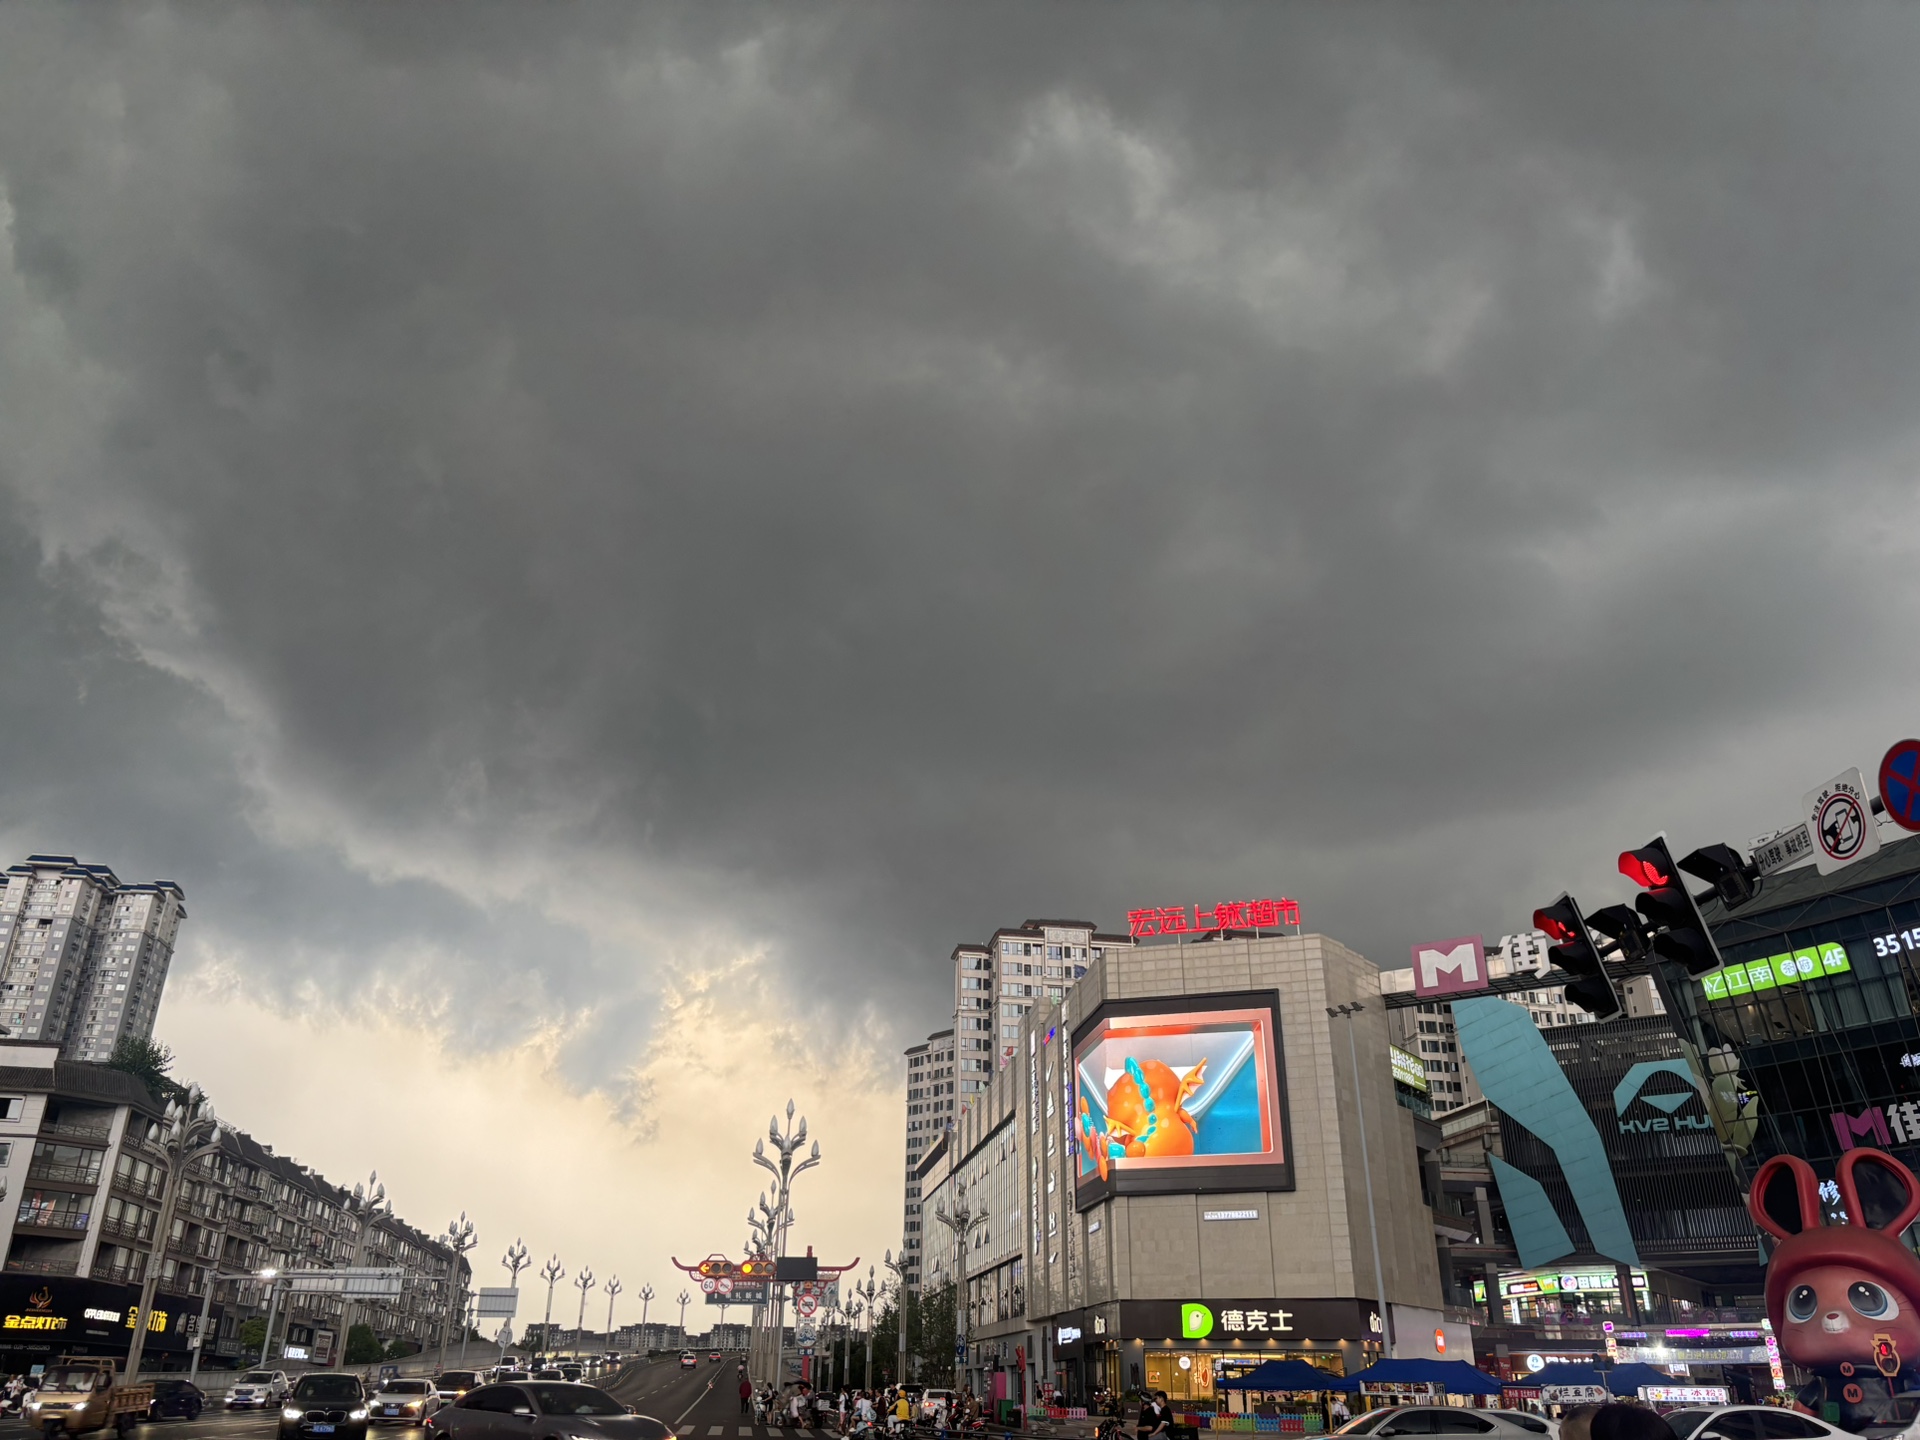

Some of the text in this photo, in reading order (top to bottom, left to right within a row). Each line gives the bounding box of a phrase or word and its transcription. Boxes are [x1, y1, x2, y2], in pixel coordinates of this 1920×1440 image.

[1822, 947, 1845, 967] 4F
[703, 1280, 714, 1290] 60
[2, 1314, 68, 1331] 金点灯饰
[125, 1305, 168, 1333] 金灯饰
[1221, 1309, 1294, 1332] 德克士
[1662, 1388, 1716, 1397] 手工冰粉
[1847, 1388, 1858, 1398] M
